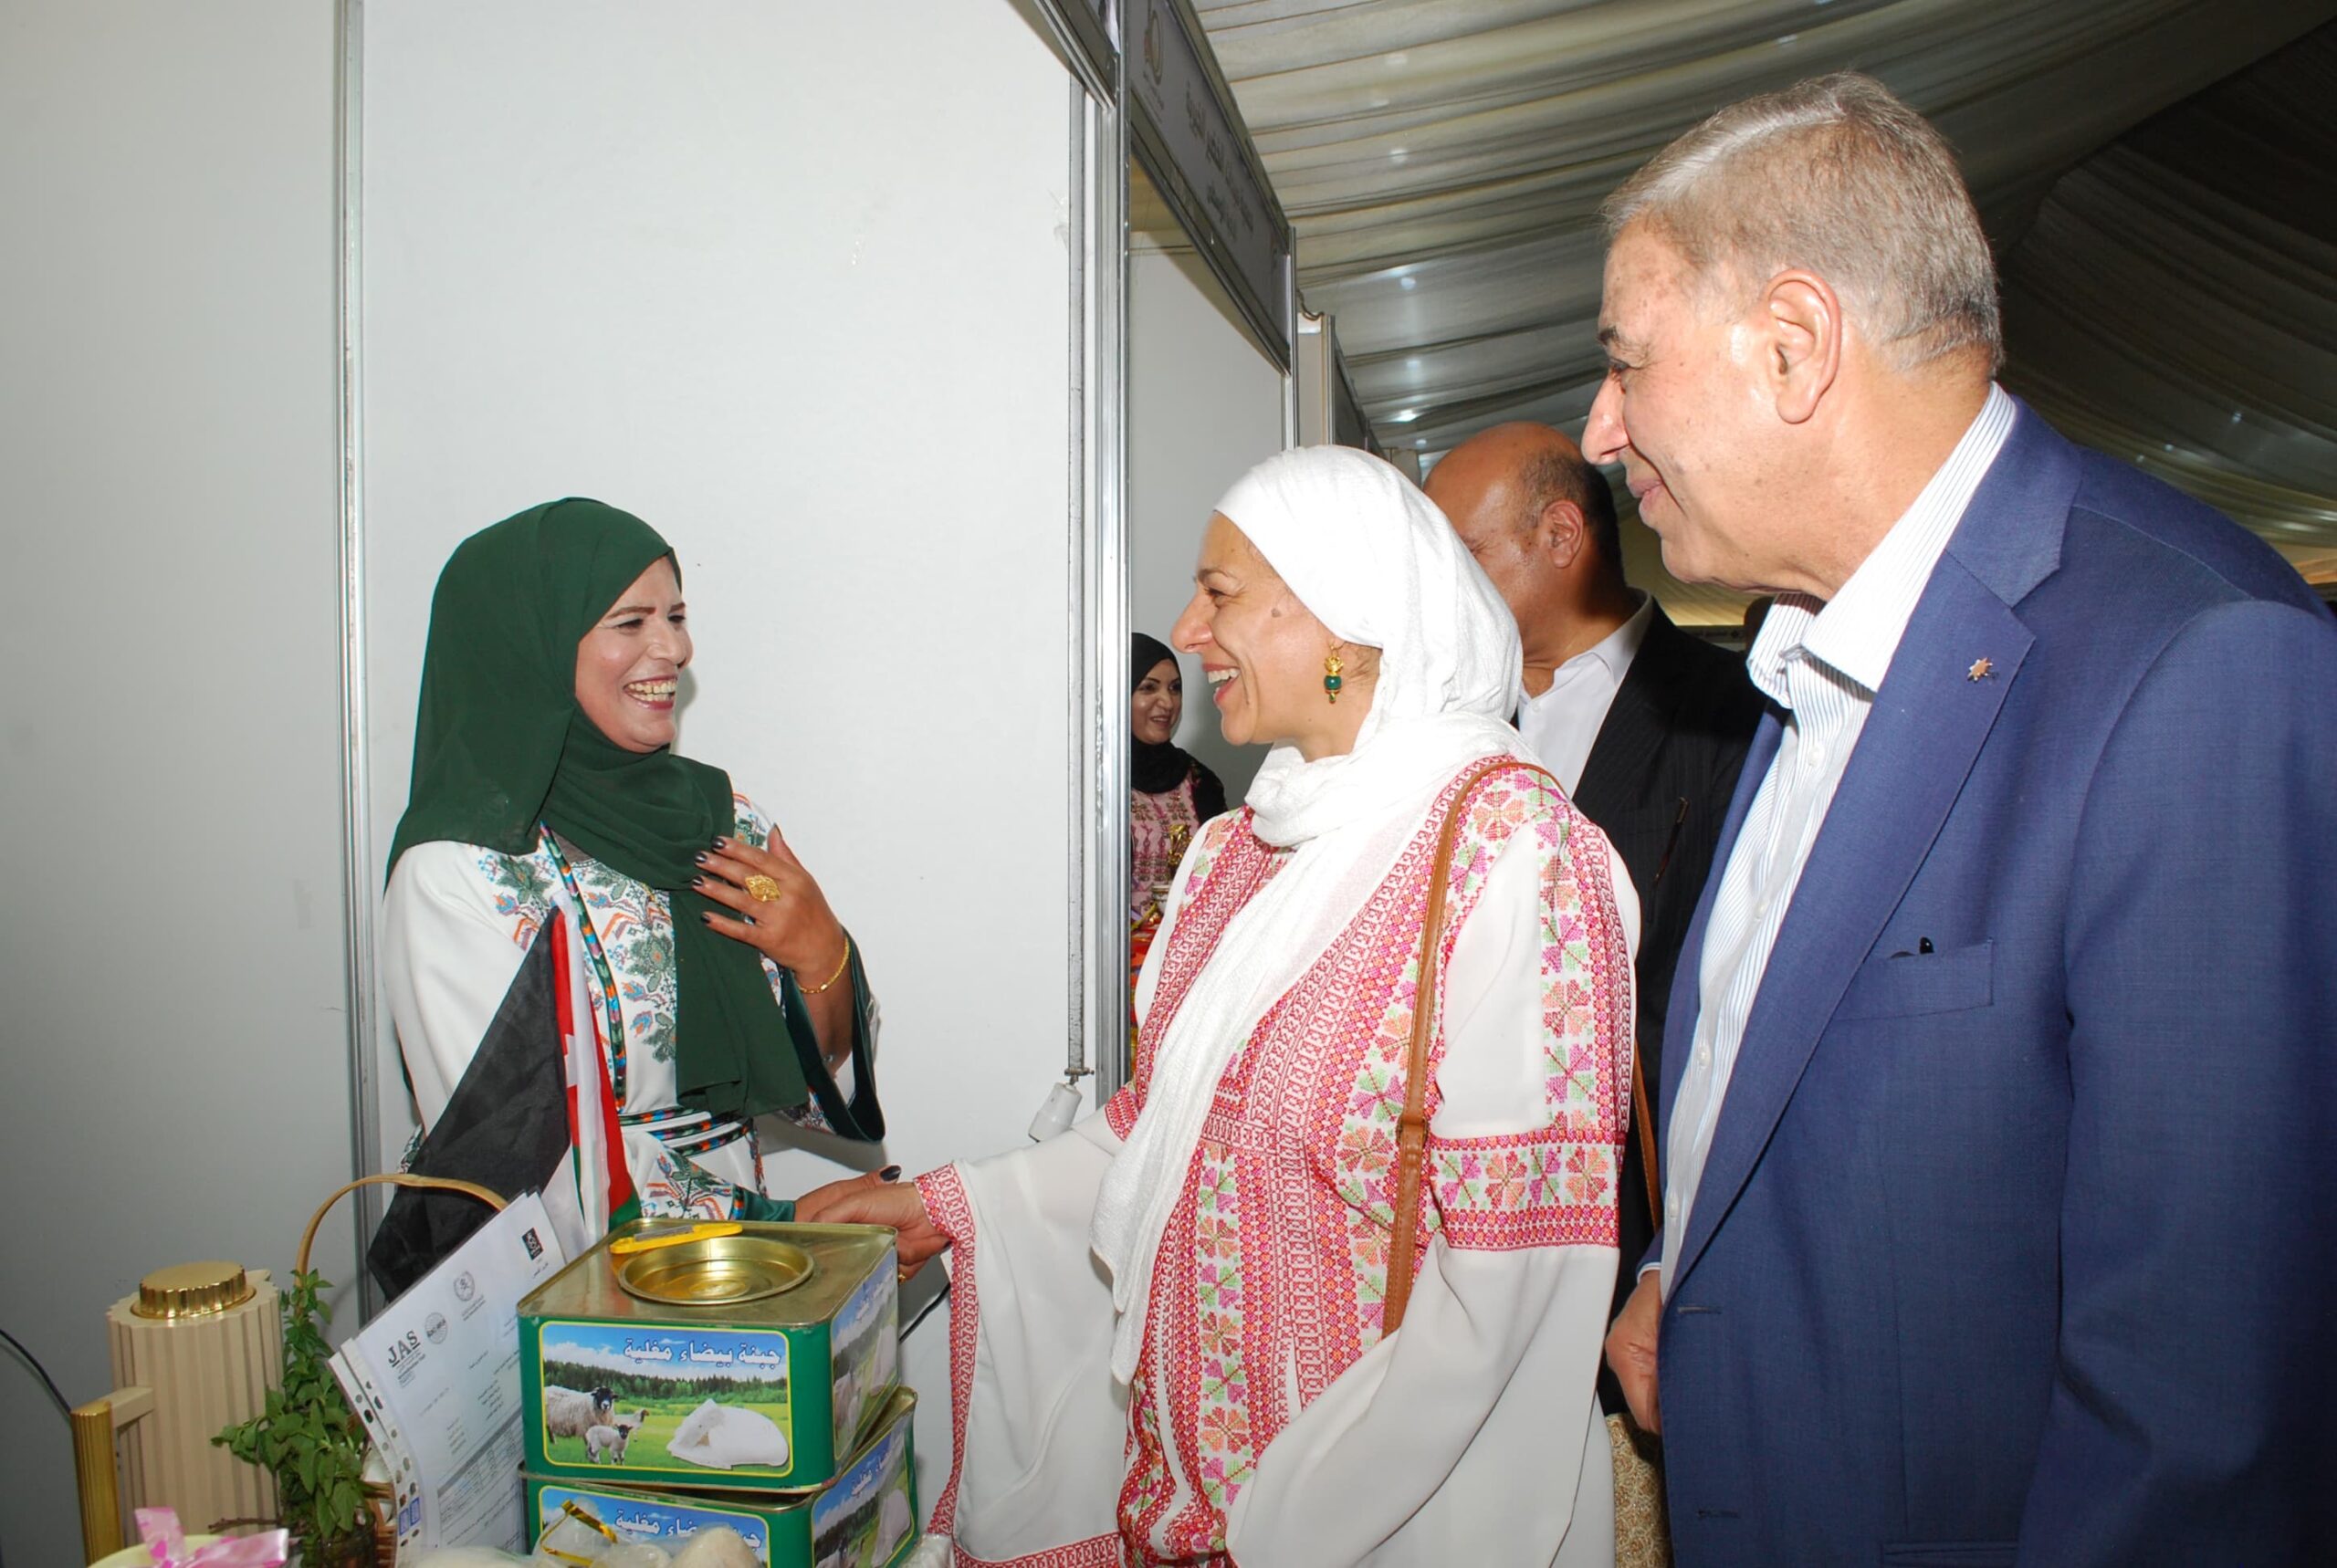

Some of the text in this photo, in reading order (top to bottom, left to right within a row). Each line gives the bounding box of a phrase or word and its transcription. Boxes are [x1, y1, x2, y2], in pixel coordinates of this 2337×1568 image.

[388, 1330, 419, 1364] JAS
[624, 1338, 781, 1369] جبنة بيضاء مغلية
[615, 1509, 660, 1535] مغلية
